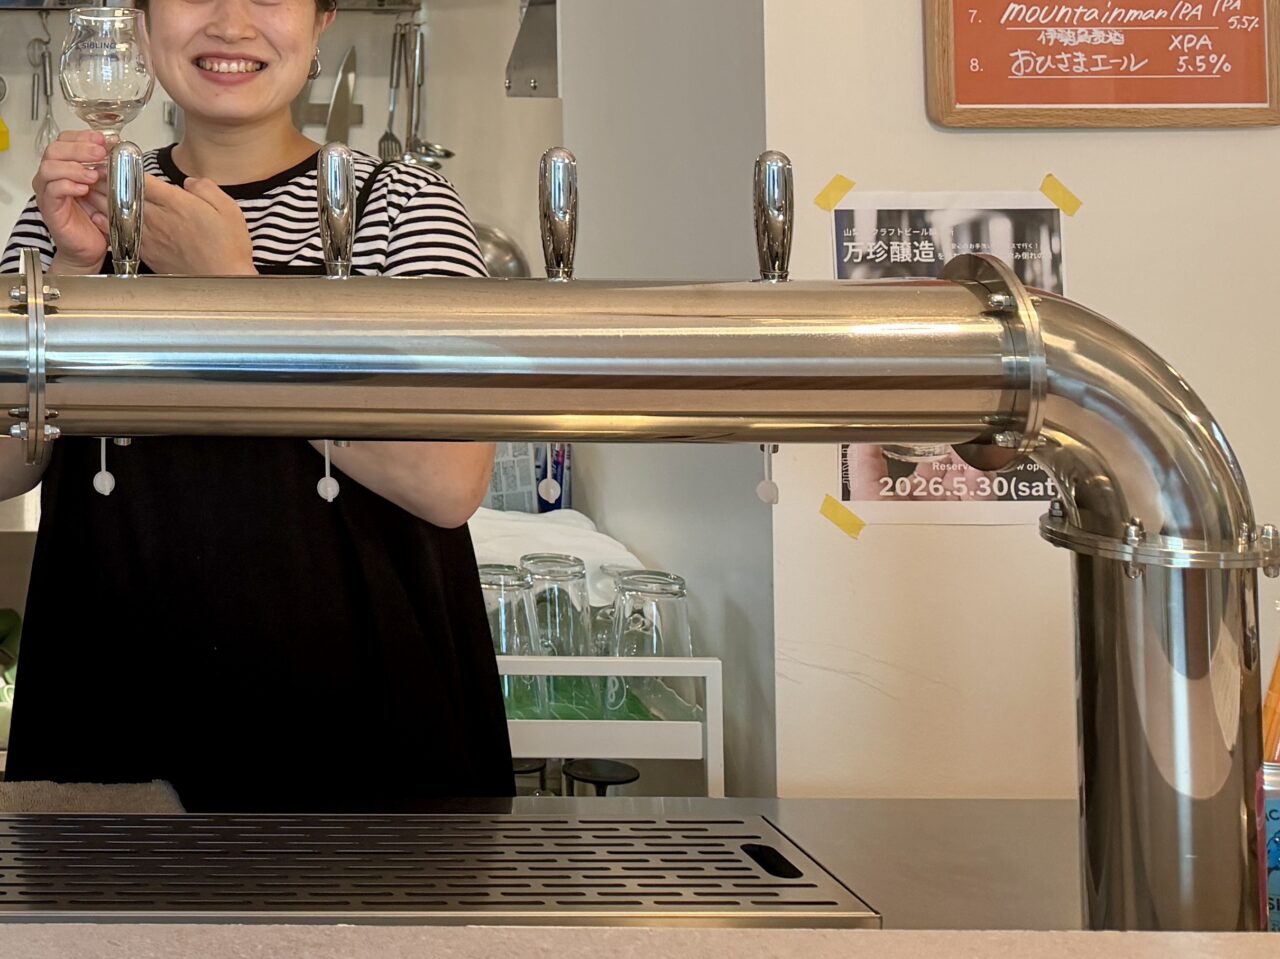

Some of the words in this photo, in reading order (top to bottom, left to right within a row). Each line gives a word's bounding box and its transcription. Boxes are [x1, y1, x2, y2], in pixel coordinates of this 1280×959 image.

[968, 9, 982, 23] 7.
[1168, 34, 1212, 53] XPA
[969, 58, 984, 72] 8.
[1008, 48, 1149, 77] おひさまエール
